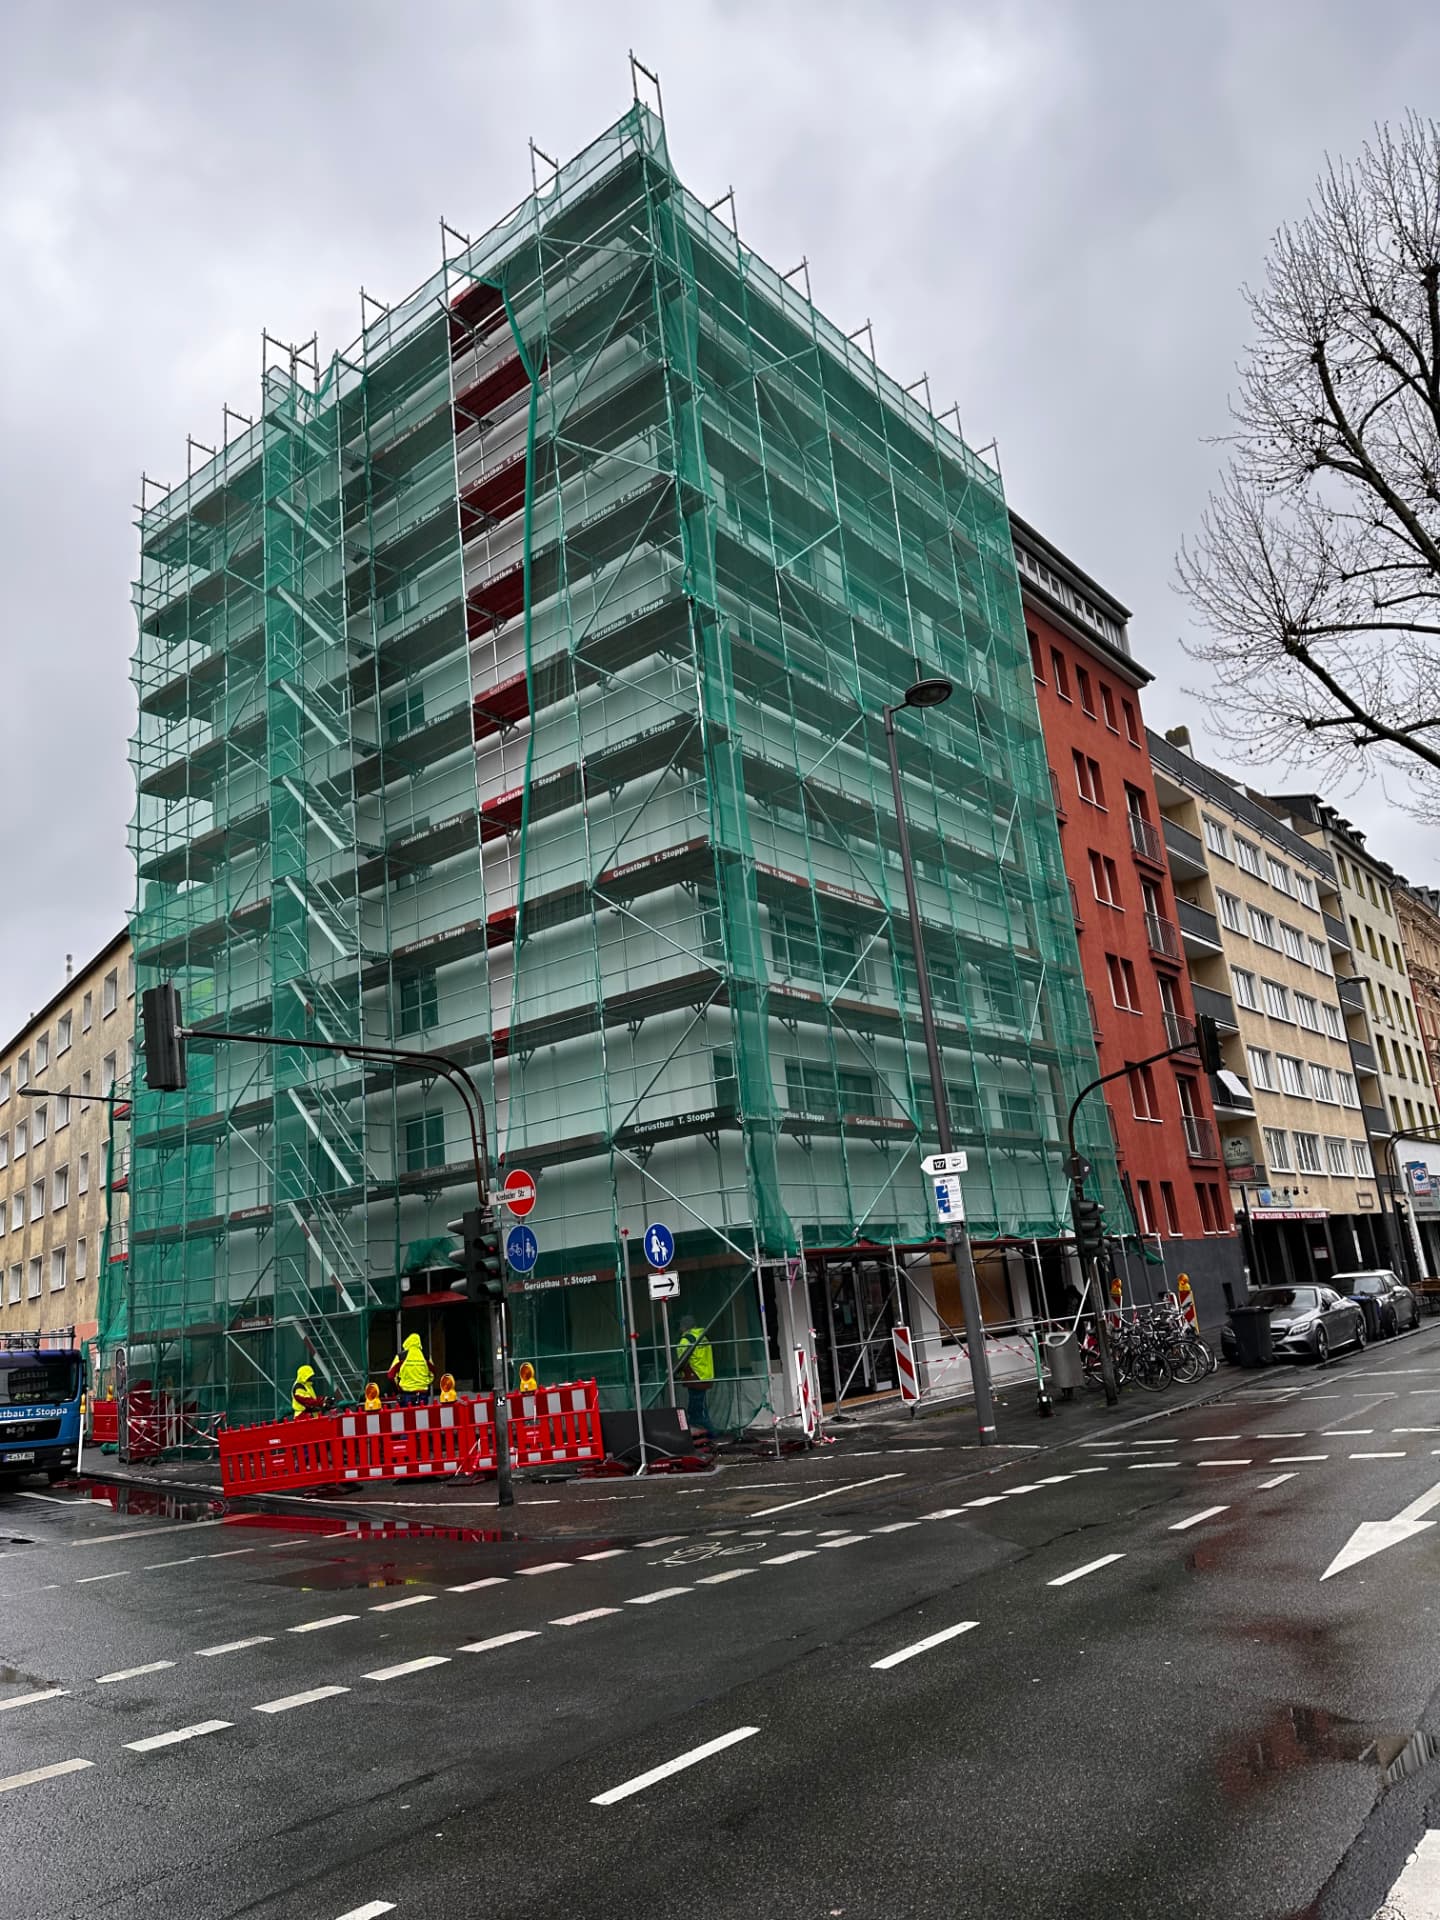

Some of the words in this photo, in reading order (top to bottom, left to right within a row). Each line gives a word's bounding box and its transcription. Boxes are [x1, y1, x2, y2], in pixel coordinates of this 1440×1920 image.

[581, 503, 617, 528] Gerüstbau
[627, 481, 652, 501] Stoppa
[482, 568, 514, 589] Gerüstbau
[638, 598, 664, 616] Stoppa
[601, 737, 638, 757] Gerüstbau
[648, 718, 676, 735] Stoppa
[537, 772, 561, 787] Stoppa
[613, 859, 651, 878] Gerüstbau
[653, 854, 660, 863] T.
[660, 844, 689, 862] Stoppa
[634, 1119, 675, 1134] Gerüstbau
[678, 1115, 686, 1125] T.
[686, 1110, 716, 1124] Stoppa
[934, 1160, 946, 1169] 127
[524, 1278, 560, 1291] Gerüstbau
[563, 1276, 570, 1286] T.
[571, 1273, 597, 1286] Stoppa
[26, 1408, 33, 1416] T.
[35, 1407, 67, 1417] Stoppa
